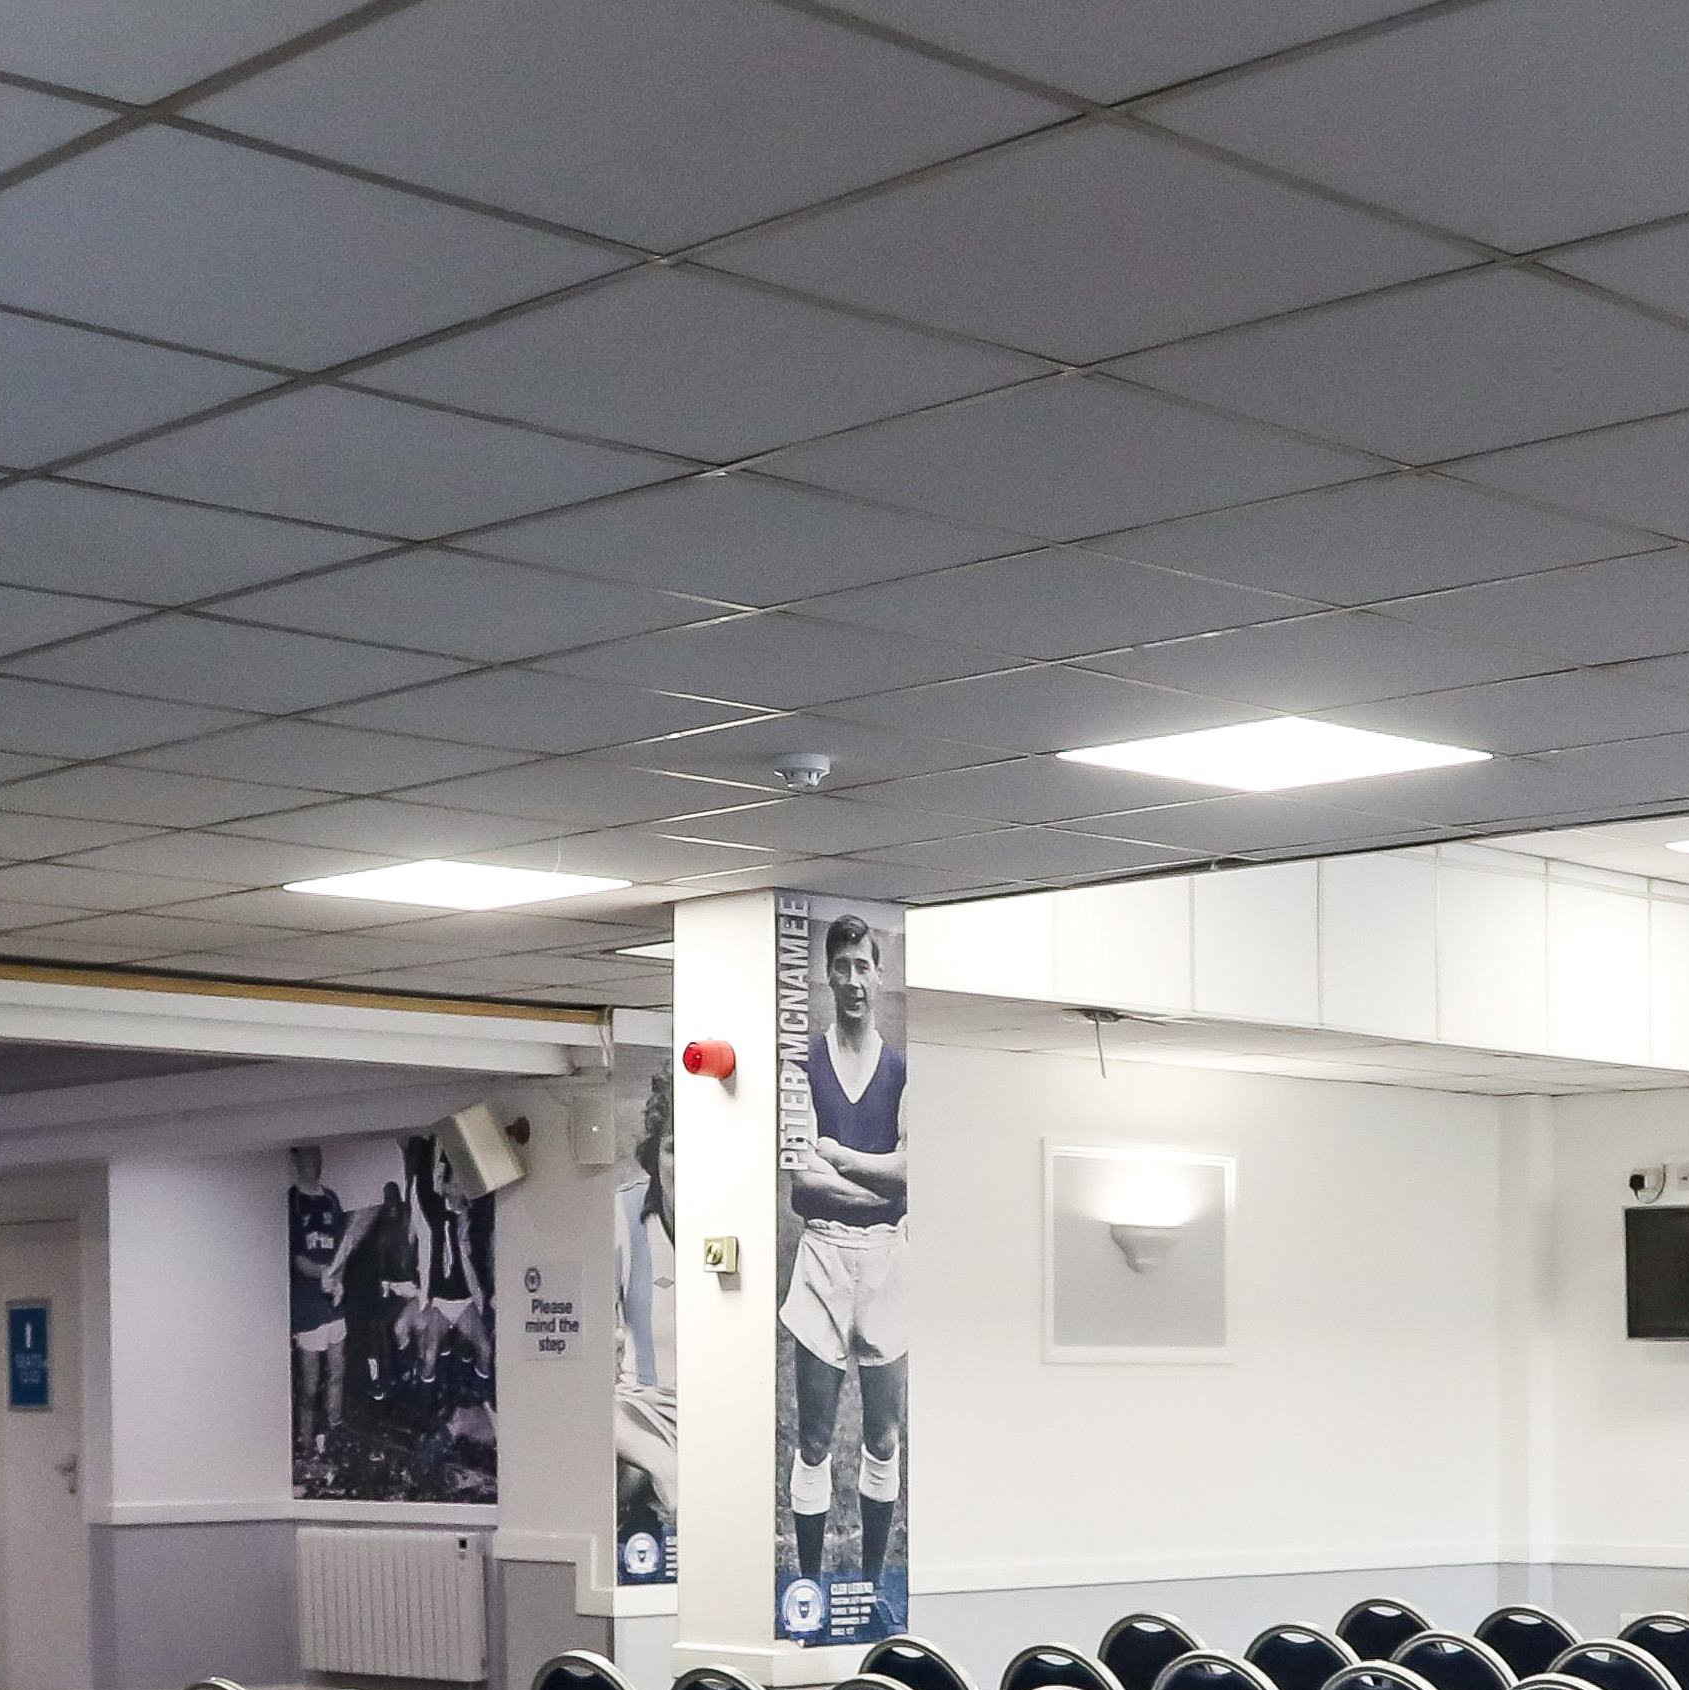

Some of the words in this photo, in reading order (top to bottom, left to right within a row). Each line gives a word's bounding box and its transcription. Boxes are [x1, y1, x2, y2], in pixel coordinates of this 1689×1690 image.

[779, 895, 810, 1061] MCNAMEE
[531, 1298, 573, 1314] Please
[525, 1317, 556, 1333] mind
[559, 1317, 579, 1333] the
[538, 1336, 566, 1354] step
